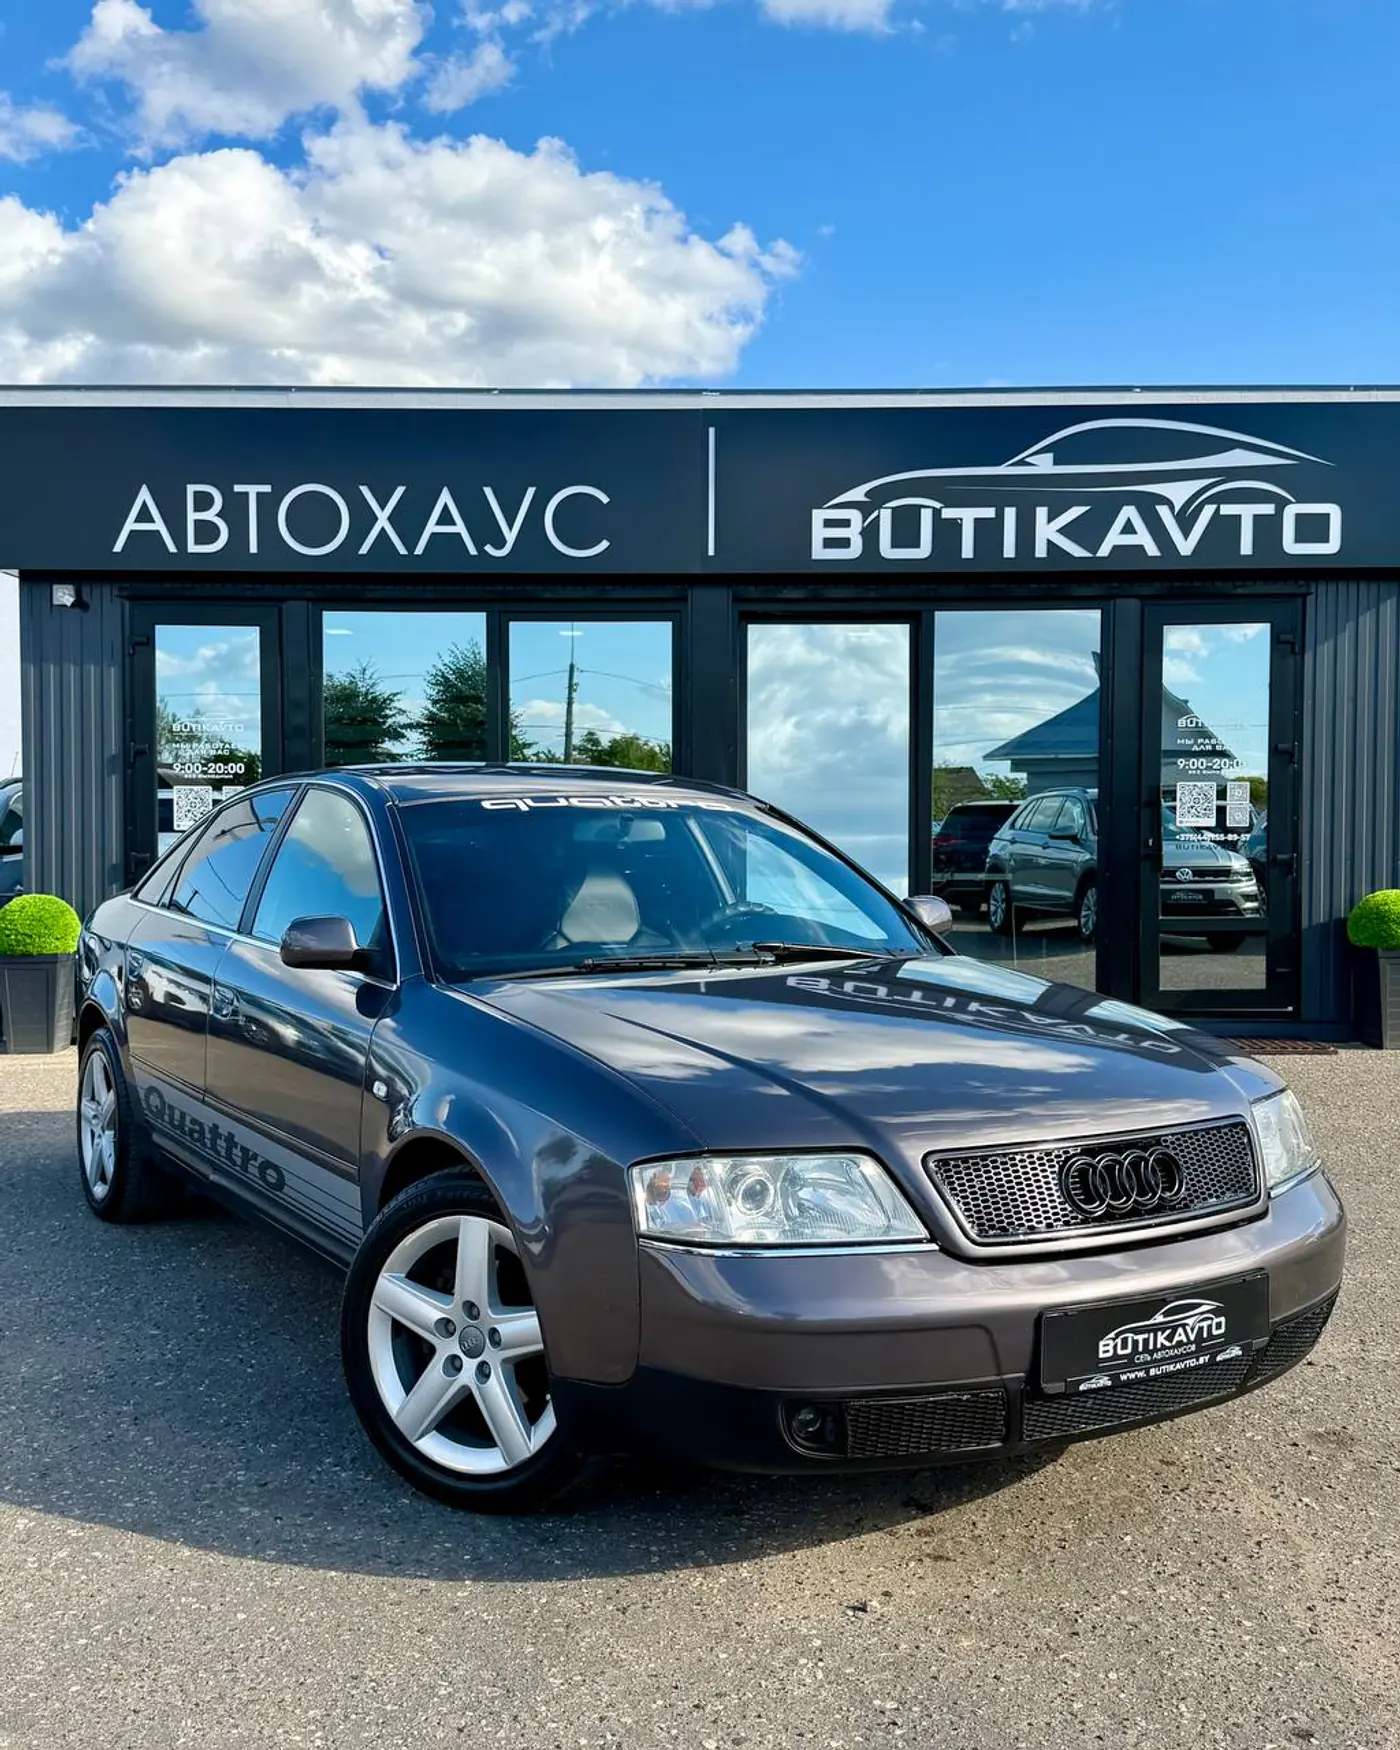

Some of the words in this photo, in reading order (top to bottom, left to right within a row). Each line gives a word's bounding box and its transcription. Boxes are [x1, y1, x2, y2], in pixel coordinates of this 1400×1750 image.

[112, 483, 612, 558] АВТОХАУС
[810, 503, 1342, 560] BUTIKAVTO
[172, 762, 245, 774] 9:00-20:00
[480, 795, 735, 812] quattro
[143, 1085, 286, 1192] Quattro
[1098, 1316, 1226, 1359] BUTIKAVTO
[1152, 1343, 1197, 1361] АВТОХАУСОВ
[1119, 1370, 1147, 1382] WWW.
[1149, 1354, 1211, 1377] BUTIKAVTO.BY
